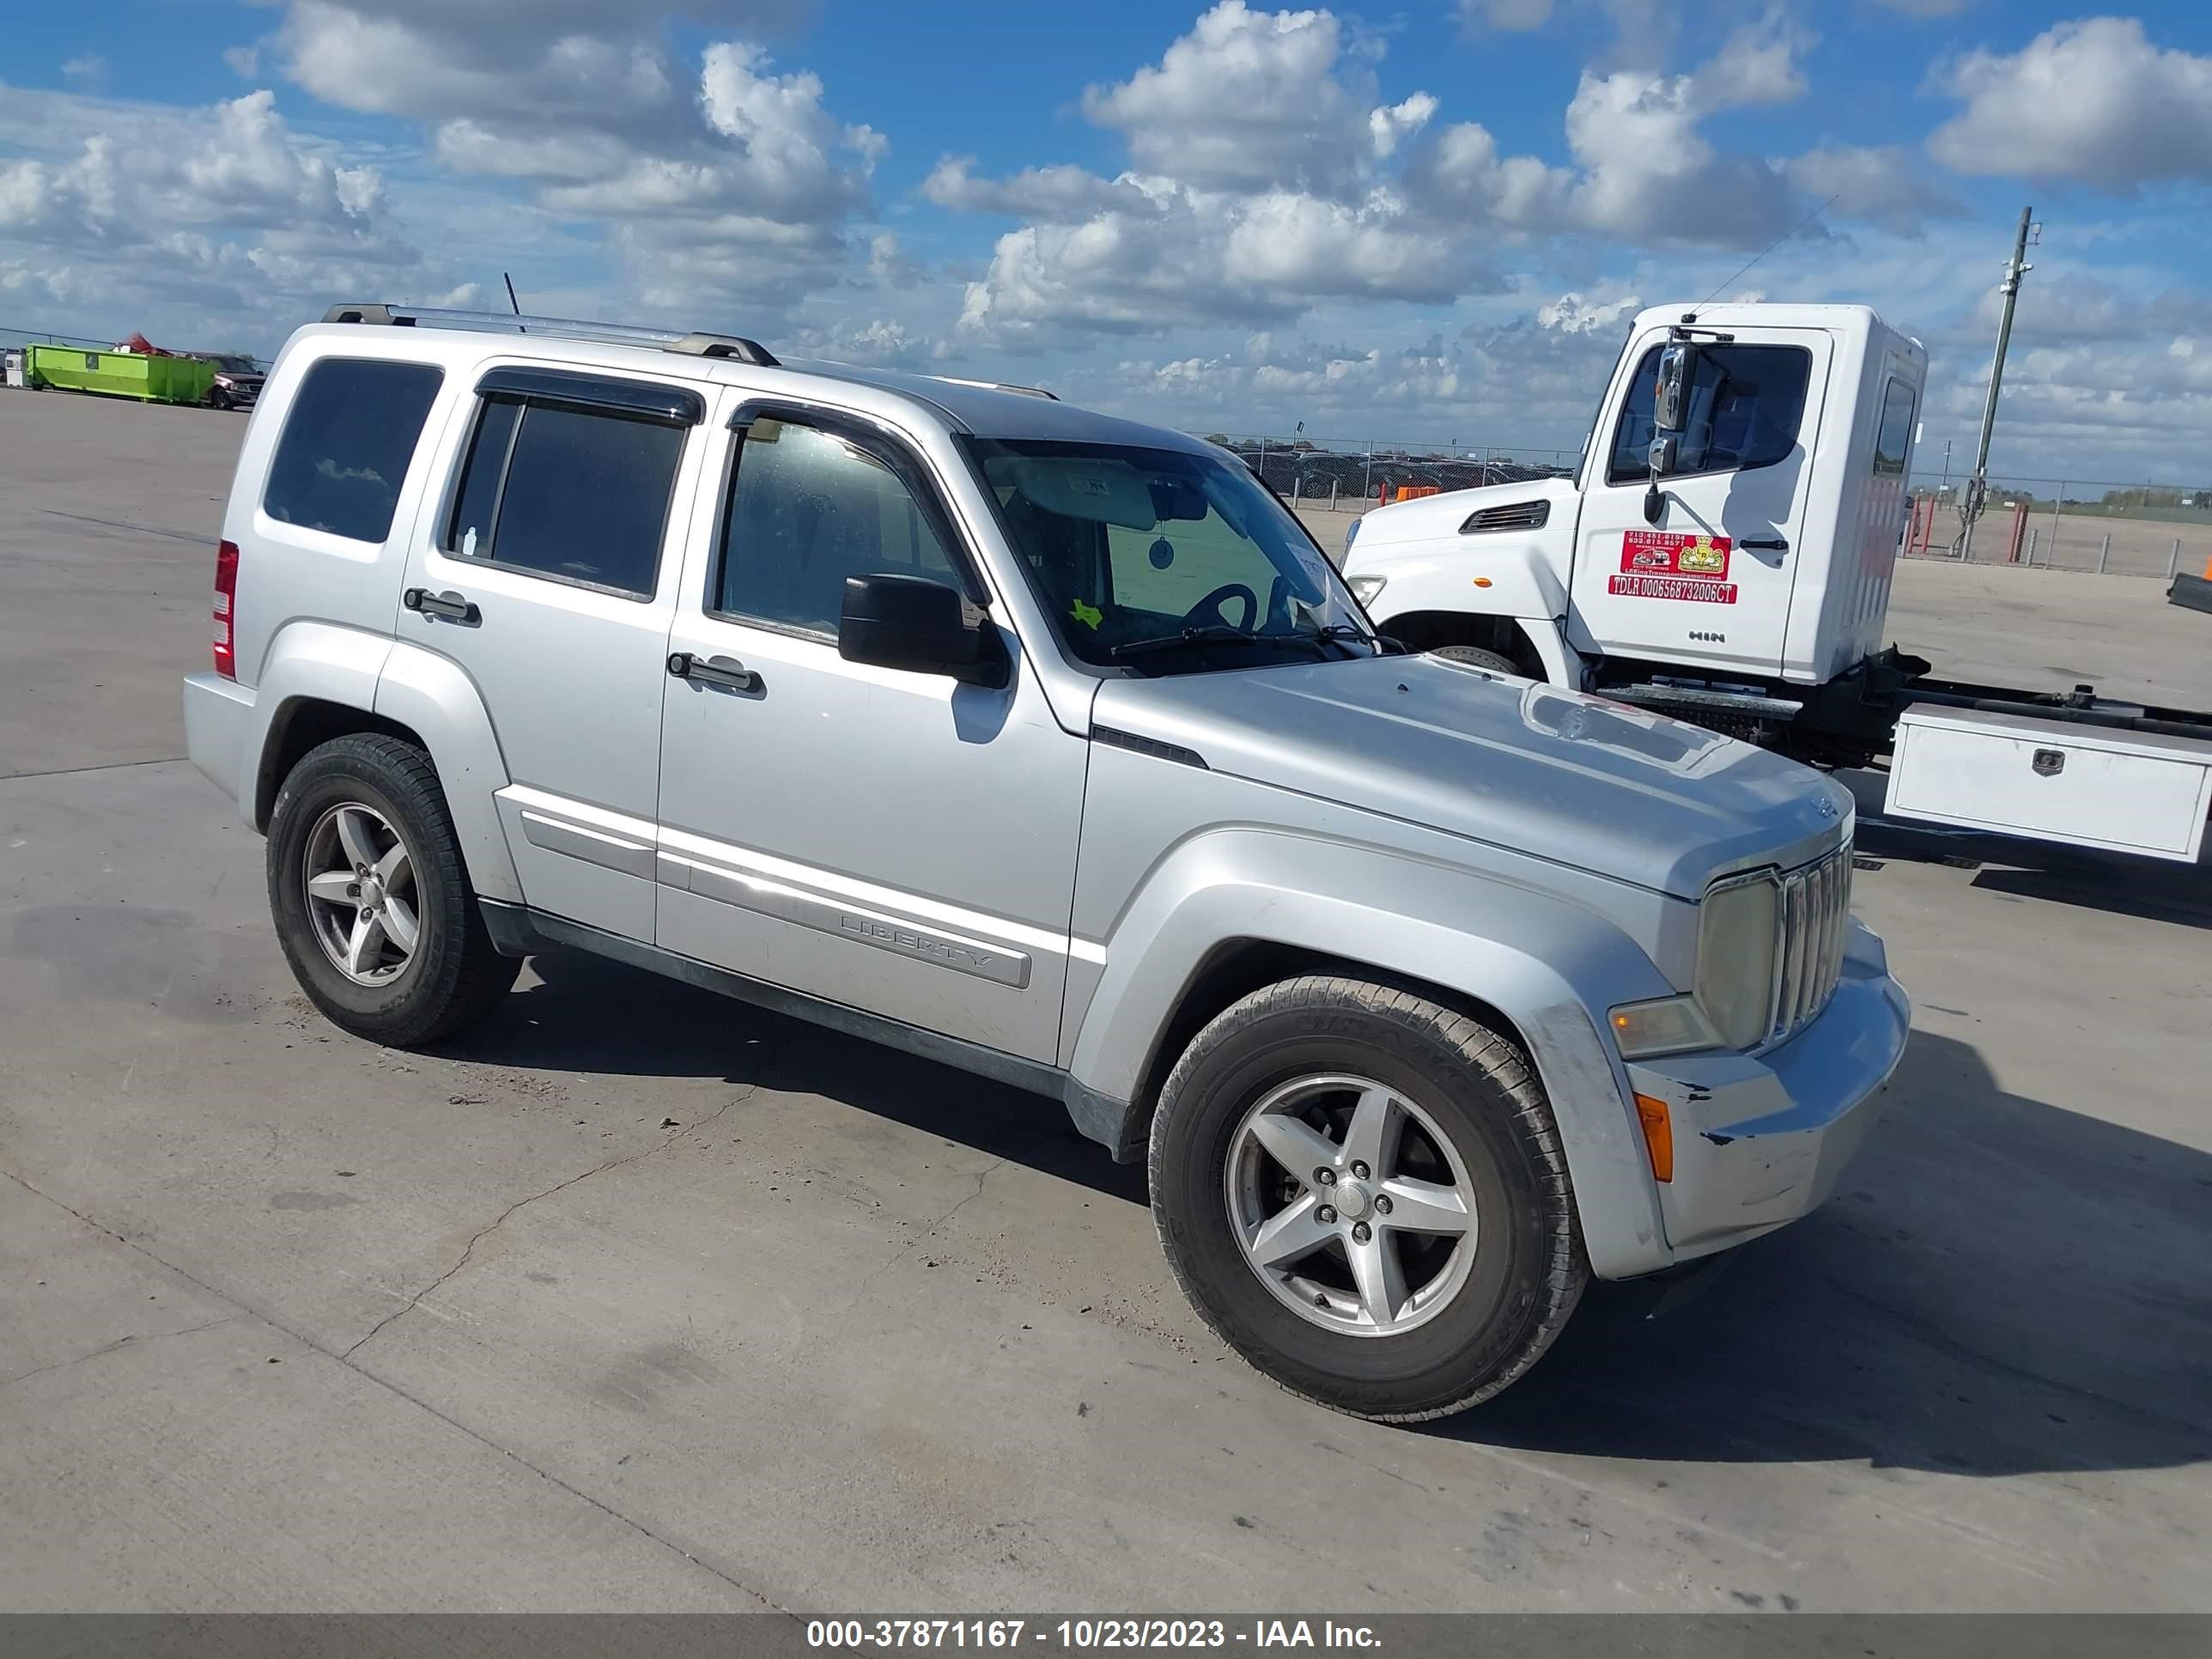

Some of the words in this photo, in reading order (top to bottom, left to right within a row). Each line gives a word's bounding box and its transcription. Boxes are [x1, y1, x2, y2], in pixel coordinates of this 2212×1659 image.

[1613, 576, 1639, 594] TDLR
[1641, 579, 1732, 603] 0006568732006CT
[840, 915, 994, 969] LIBERTY
